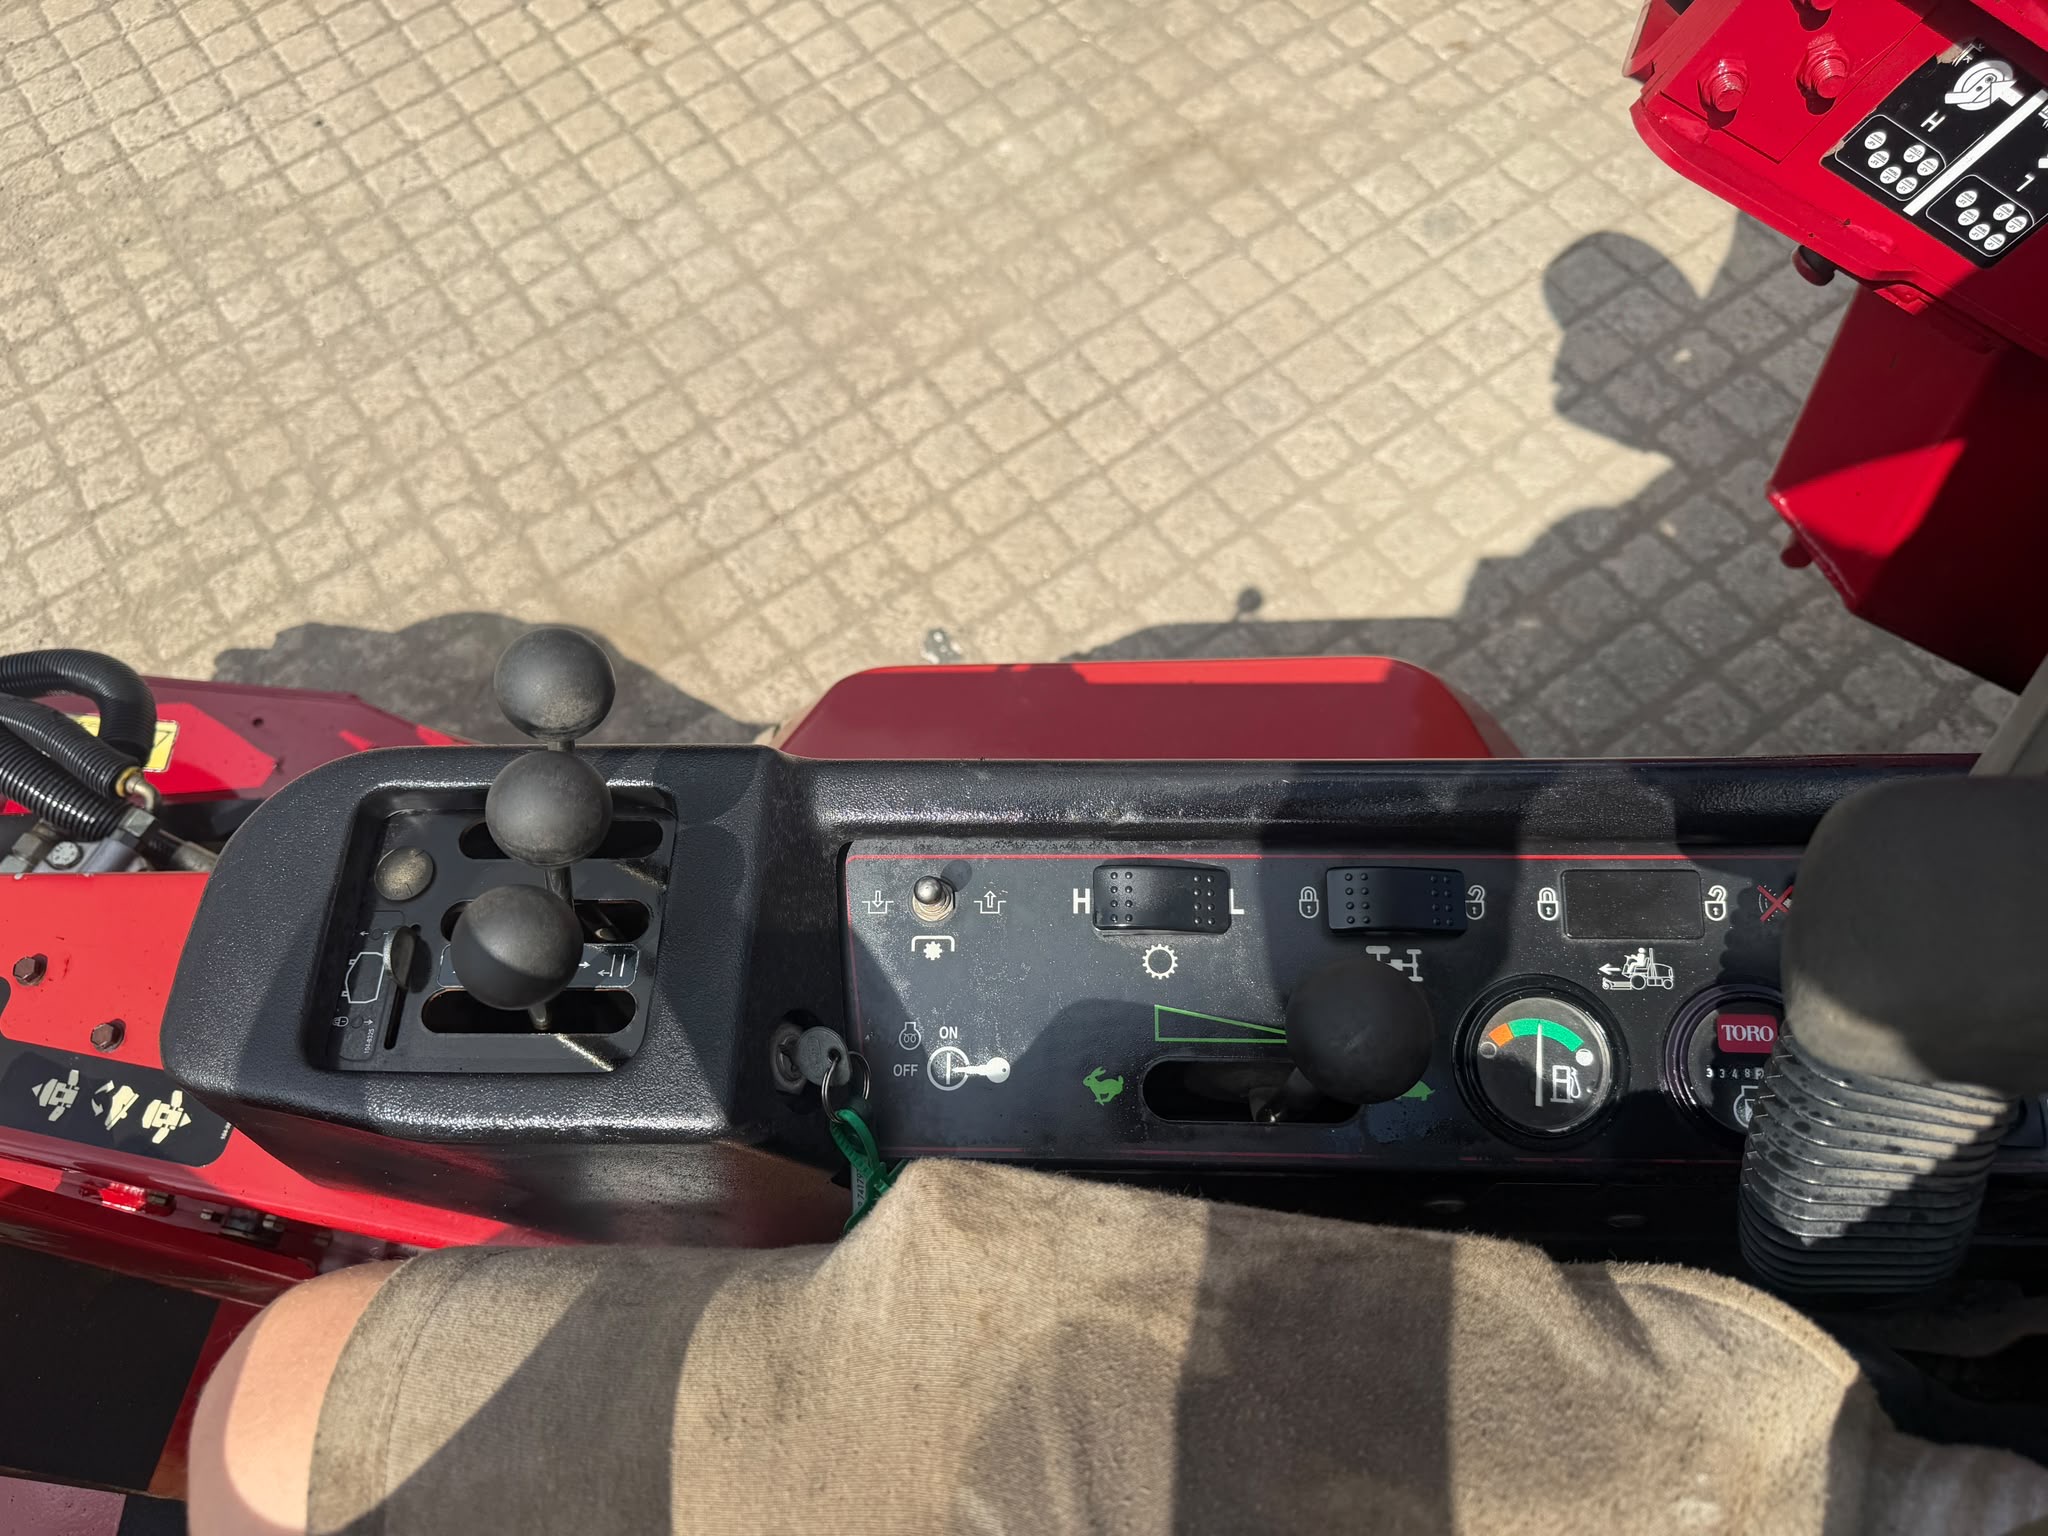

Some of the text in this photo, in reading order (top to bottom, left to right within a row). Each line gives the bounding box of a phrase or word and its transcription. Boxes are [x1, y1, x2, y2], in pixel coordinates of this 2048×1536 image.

[1920, 110, 1946, 132] H
[1072, 888, 1091, 914] H
[1229, 888, 1245, 915] L
[939, 1026, 958, 1040] ON
[1721, 1024, 1774, 1042] TORO
[893, 1063, 918, 1077] OFF
